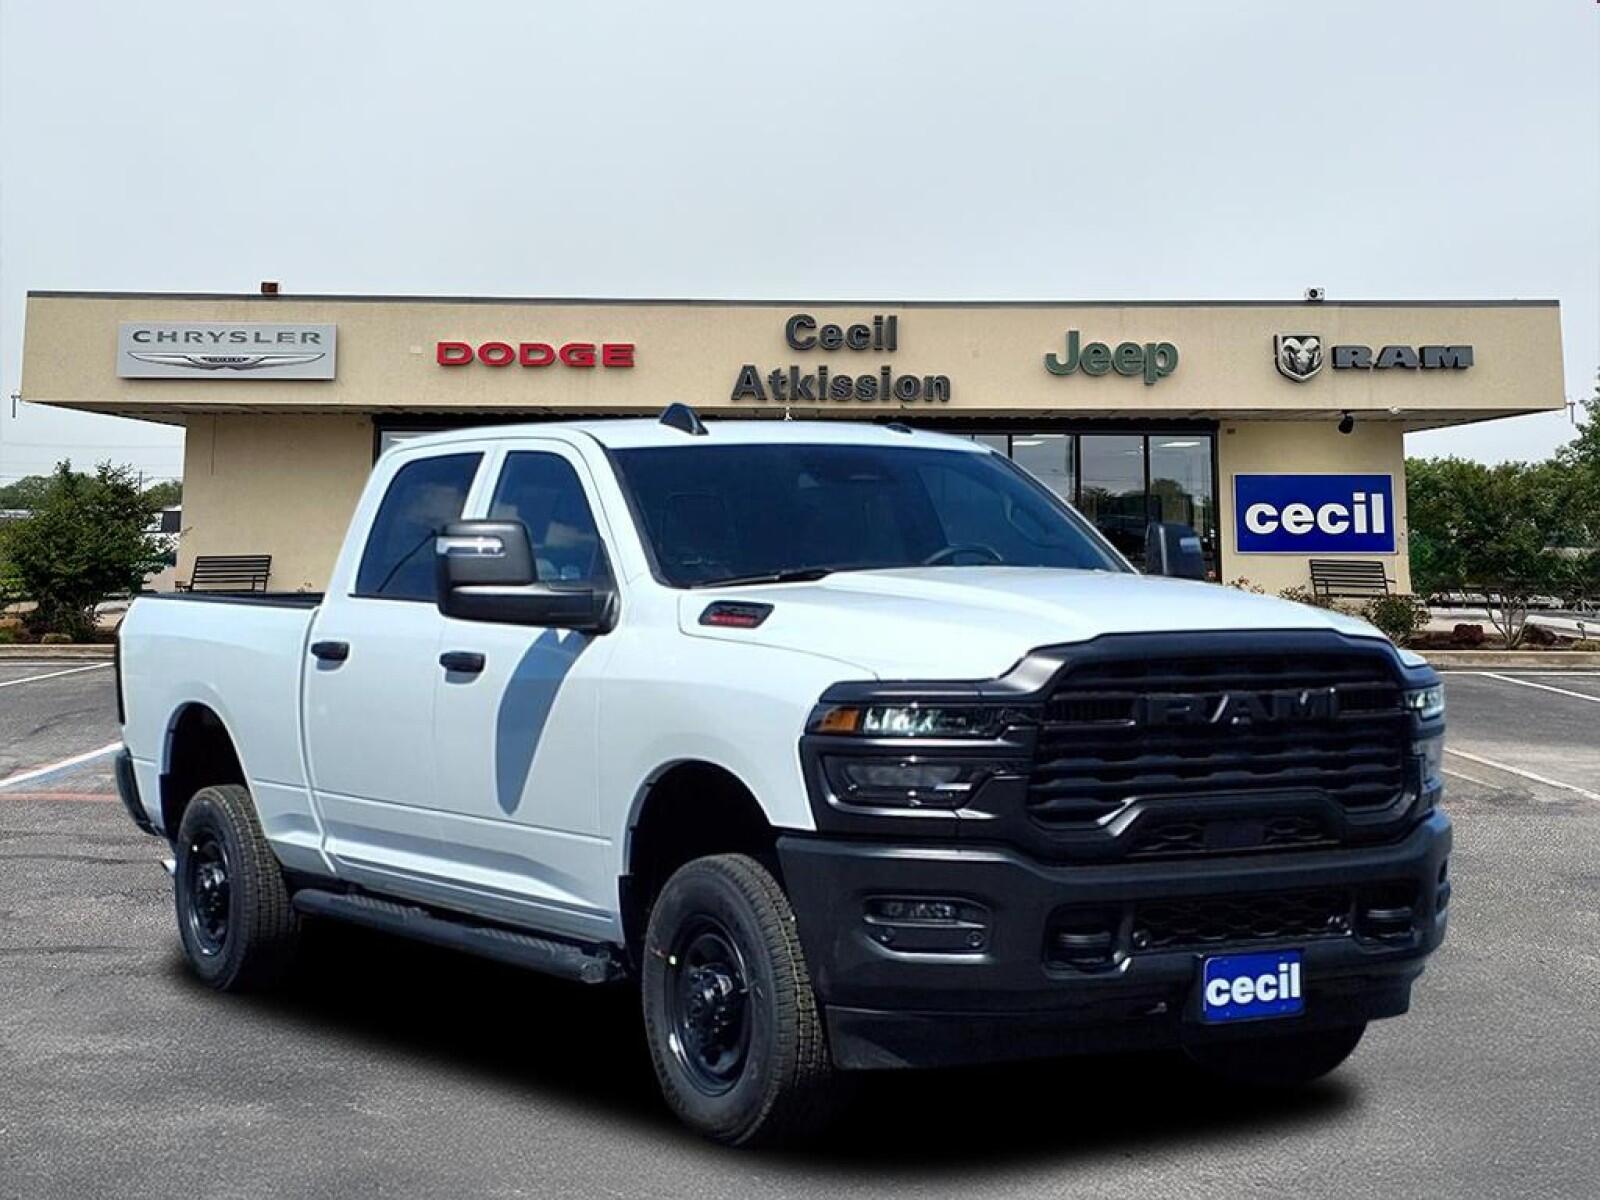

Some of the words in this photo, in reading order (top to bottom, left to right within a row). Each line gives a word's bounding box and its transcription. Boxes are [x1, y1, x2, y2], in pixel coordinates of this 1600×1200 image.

[132, 330, 321, 345] CHRYSLER
[785, 313, 898, 351] Cecil
[437, 342, 635, 367] DODGE
[1045, 330, 1179, 386] Jeep
[1331, 345, 1474, 369] RAM
[731, 364, 951, 401] Atkission
[1245, 491, 1386, 534] cecil
[1137, 688, 1337, 725] RAM
[1206, 962, 1301, 1007] cecil
